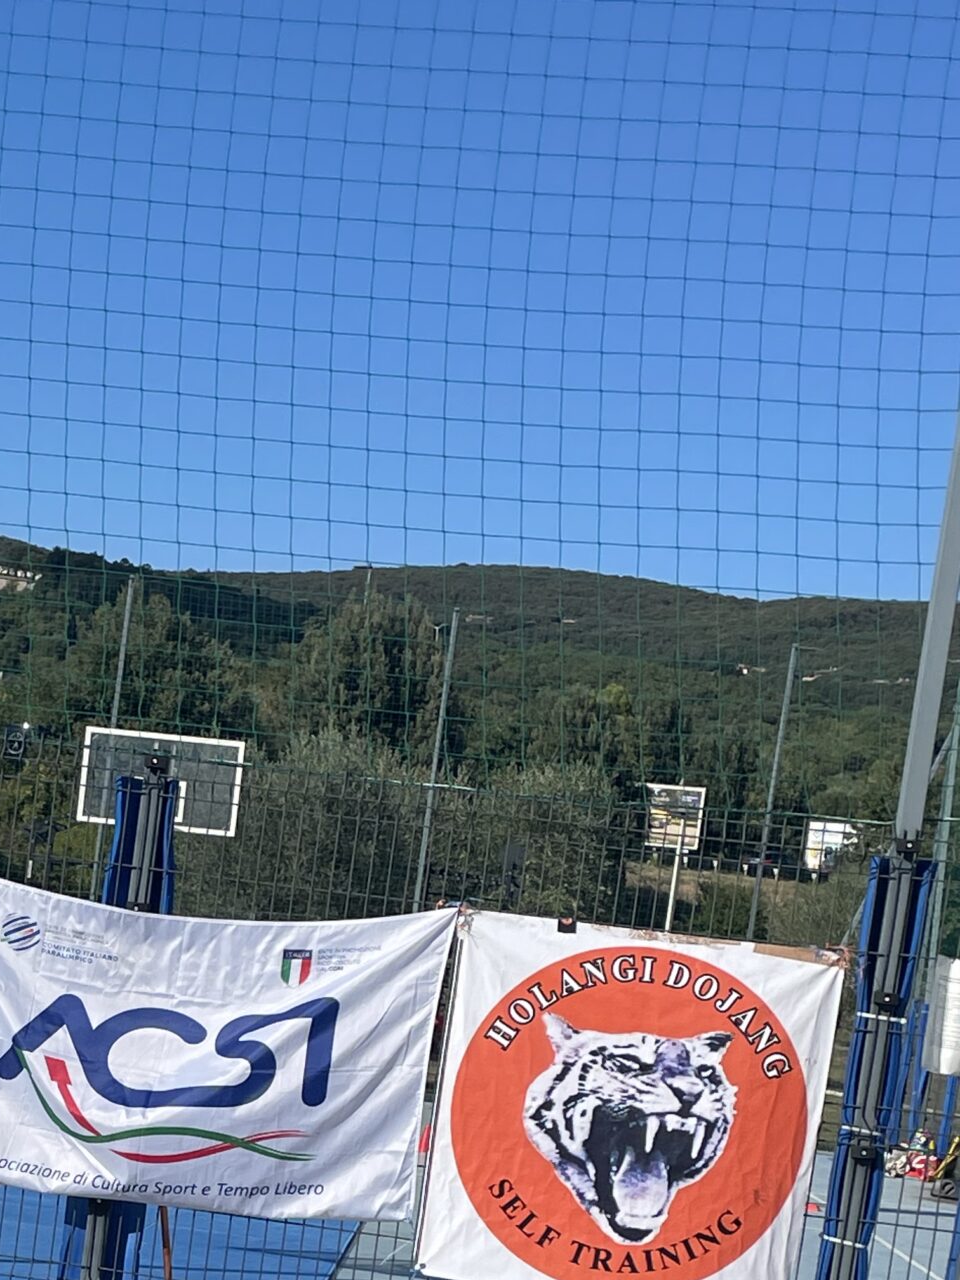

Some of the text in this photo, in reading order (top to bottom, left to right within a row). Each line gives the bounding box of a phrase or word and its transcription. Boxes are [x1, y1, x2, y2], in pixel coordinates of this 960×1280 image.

[41, 948, 93, 964] PARALIMPICO
[42, 942, 119, 962] COMITATO ITALIANO
[484, 954, 792, 1080] HOLANGI DOJANG
[74, 1171, 88, 1186] di
[91, 1174, 148, 1193] Cultura
[153, 1181, 197, 1196] Sport
[201, 1186, 211, 1196] e
[217, 1182, 270, 1199] Tempo
[274, 1182, 324, 1196] Libero
[488, 1177, 743, 1275] SELF TRAINING
